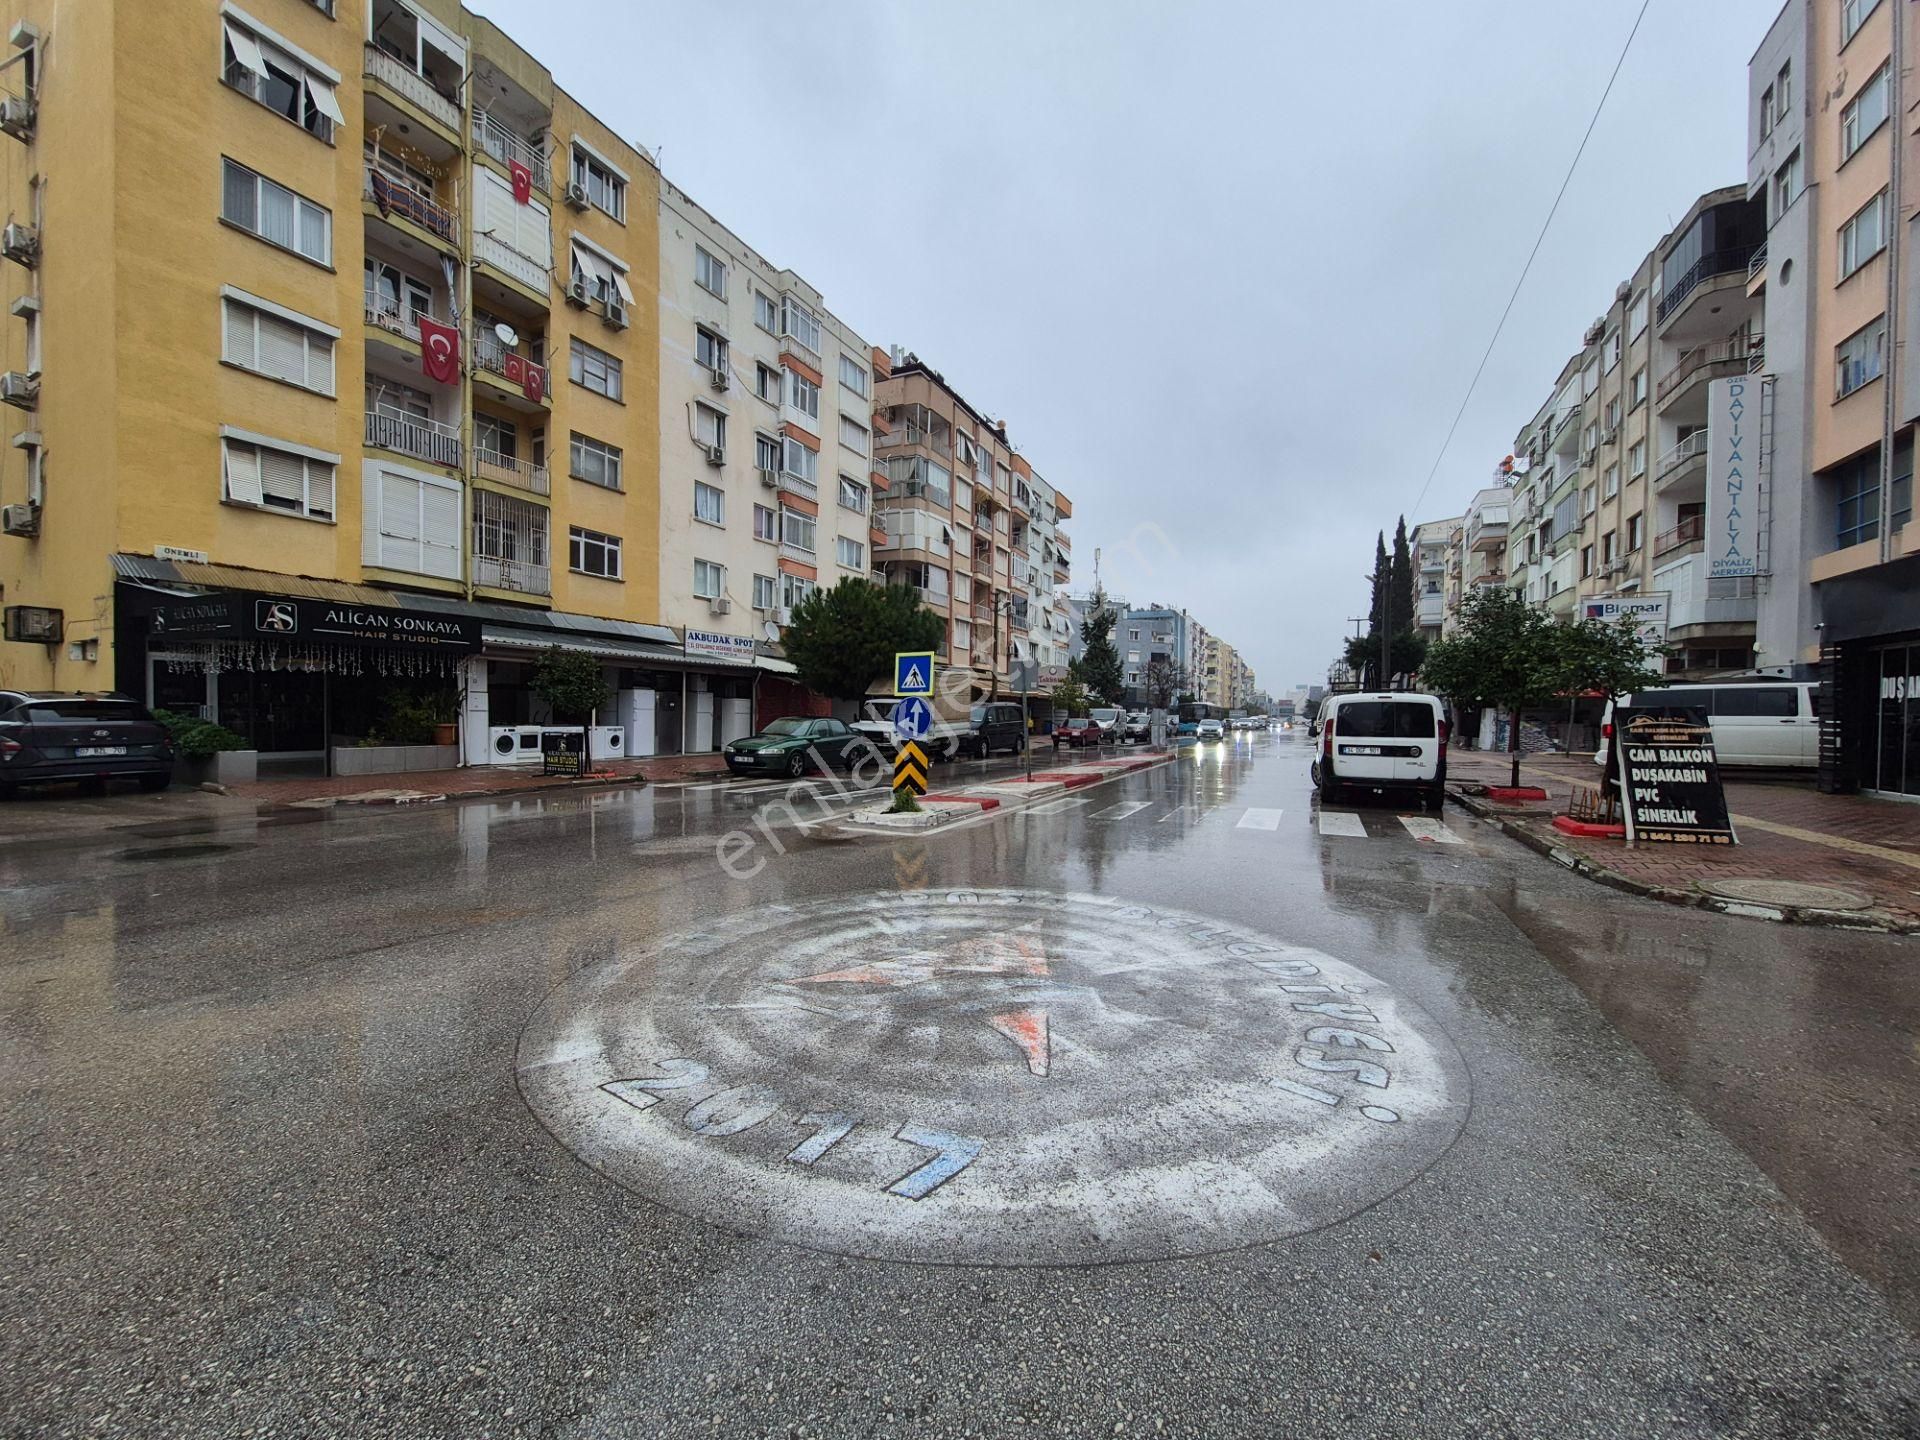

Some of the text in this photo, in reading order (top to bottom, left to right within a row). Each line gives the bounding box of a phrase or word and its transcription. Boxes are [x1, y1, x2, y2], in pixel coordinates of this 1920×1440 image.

[1726, 467, 1743, 557] ANTALYA
[1713, 558, 1752, 568] DİYALİZ
[1711, 566, 1754, 576] MERKEZİ
[325, 608, 462, 635] ALİCAN SONKAYA
[354, 631, 439, 644] HAIR STUDIO
[688, 632, 753, 647] AKBUDAK SPOT
[1629, 749, 1713, 762] CAM BALKON
[1632, 765, 1707, 785] DUŞAKABİN
[1634, 788, 1660, 802] PVC
[1637, 804, 1698, 824] SİNEKLİK
[598, 1057, 984, 1202] 2017
